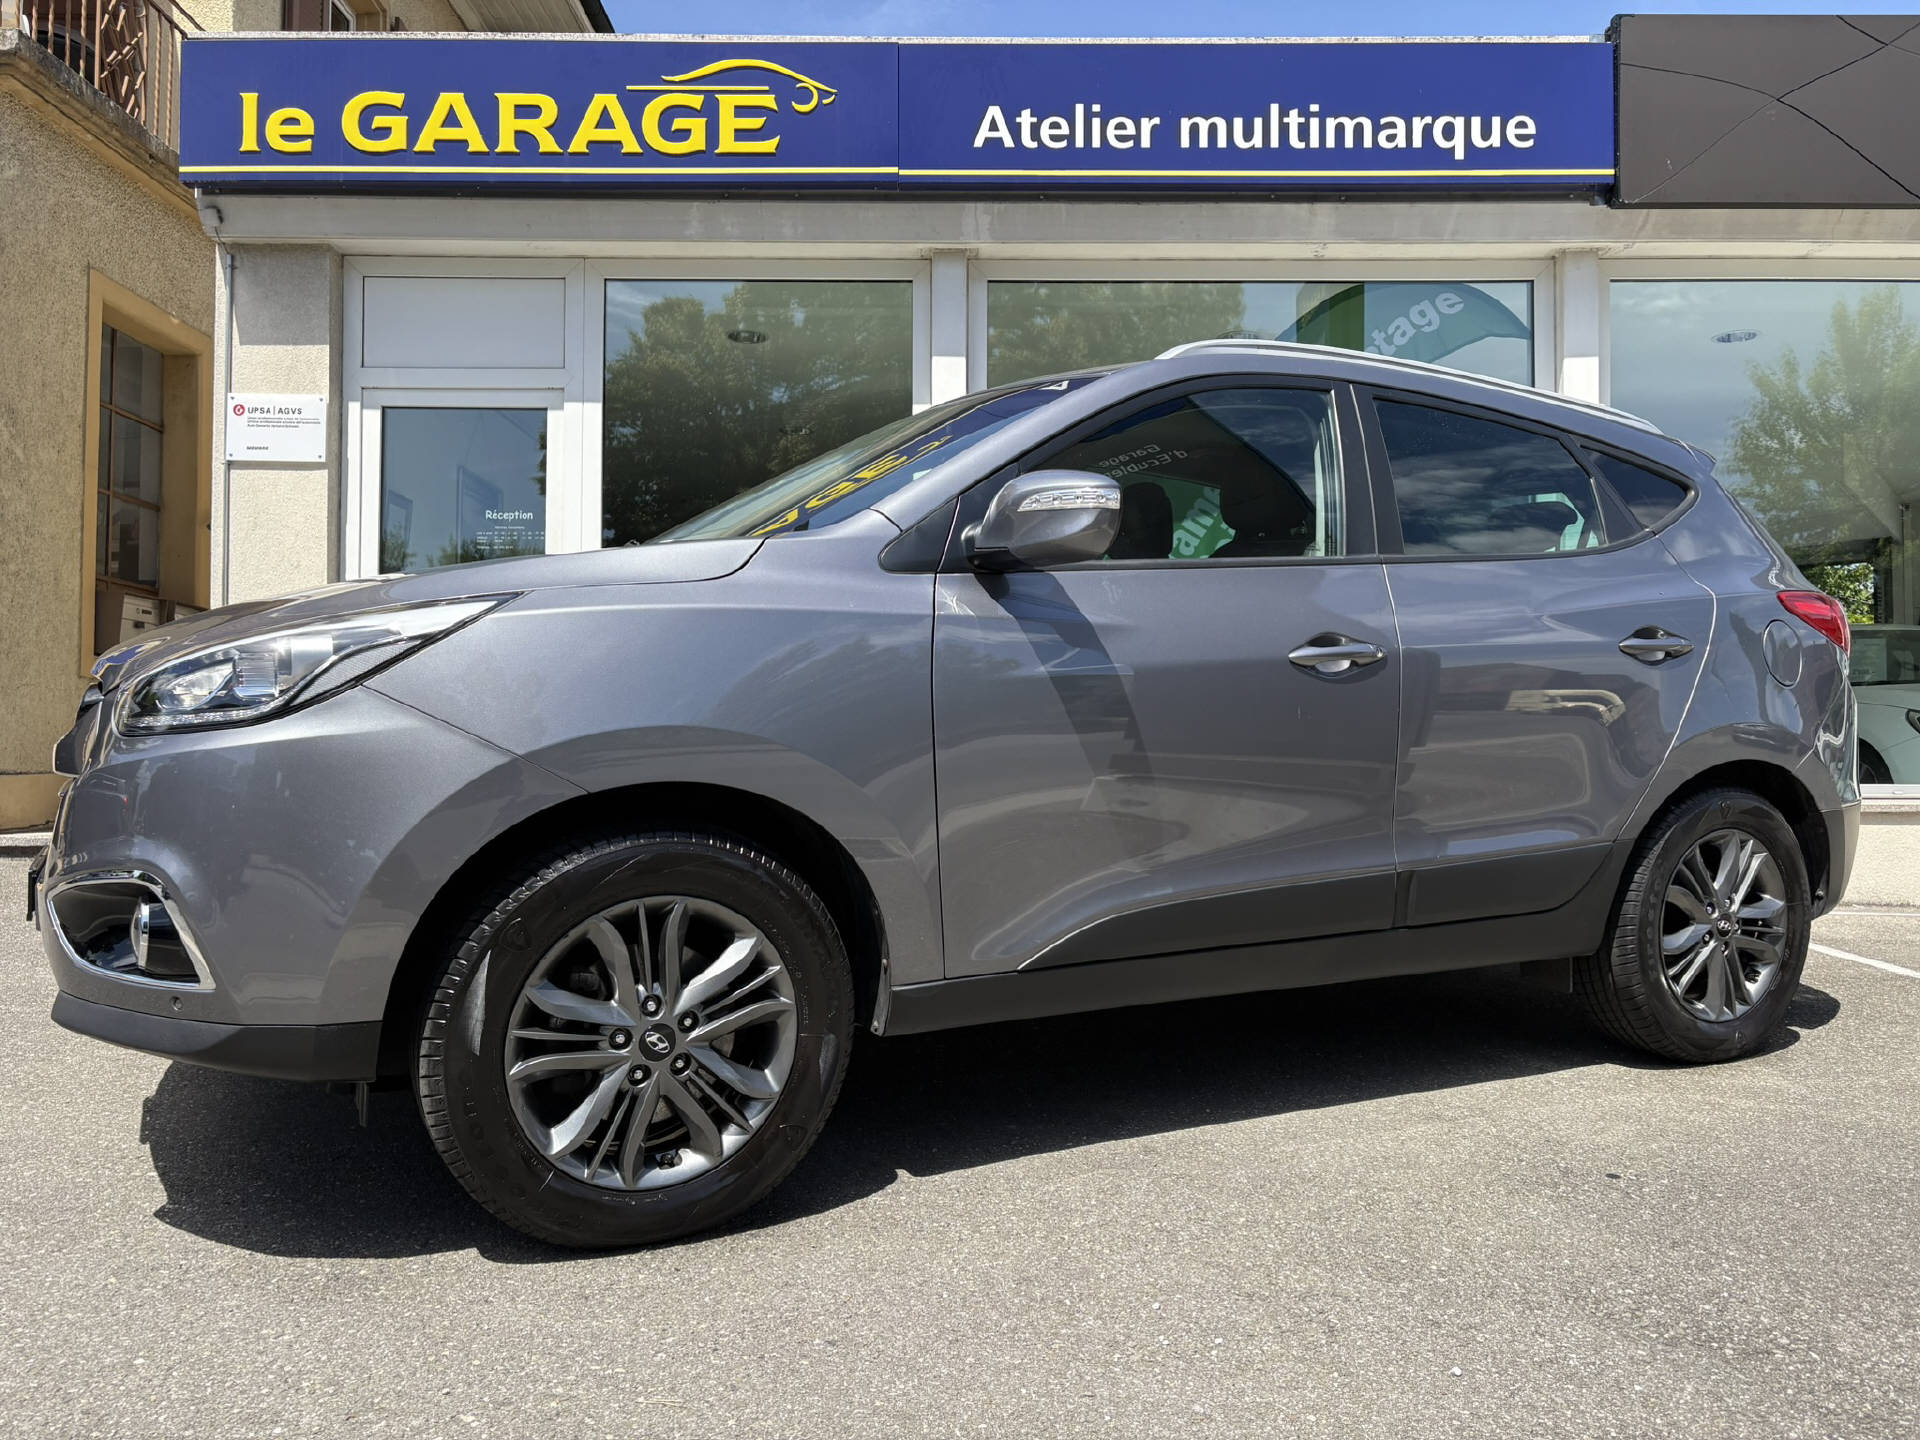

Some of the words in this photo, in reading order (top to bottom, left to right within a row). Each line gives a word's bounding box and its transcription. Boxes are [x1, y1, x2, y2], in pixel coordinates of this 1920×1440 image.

[239, 91, 315, 152] le
[340, 90, 781, 154] GARAGE
[972, 103, 1160, 149] Atelier
[1179, 103, 1537, 160] multimarque
[247, 407, 271, 415] UPSA
[277, 407, 302, 415] AGVS
[485, 509, 533, 522] Réception
